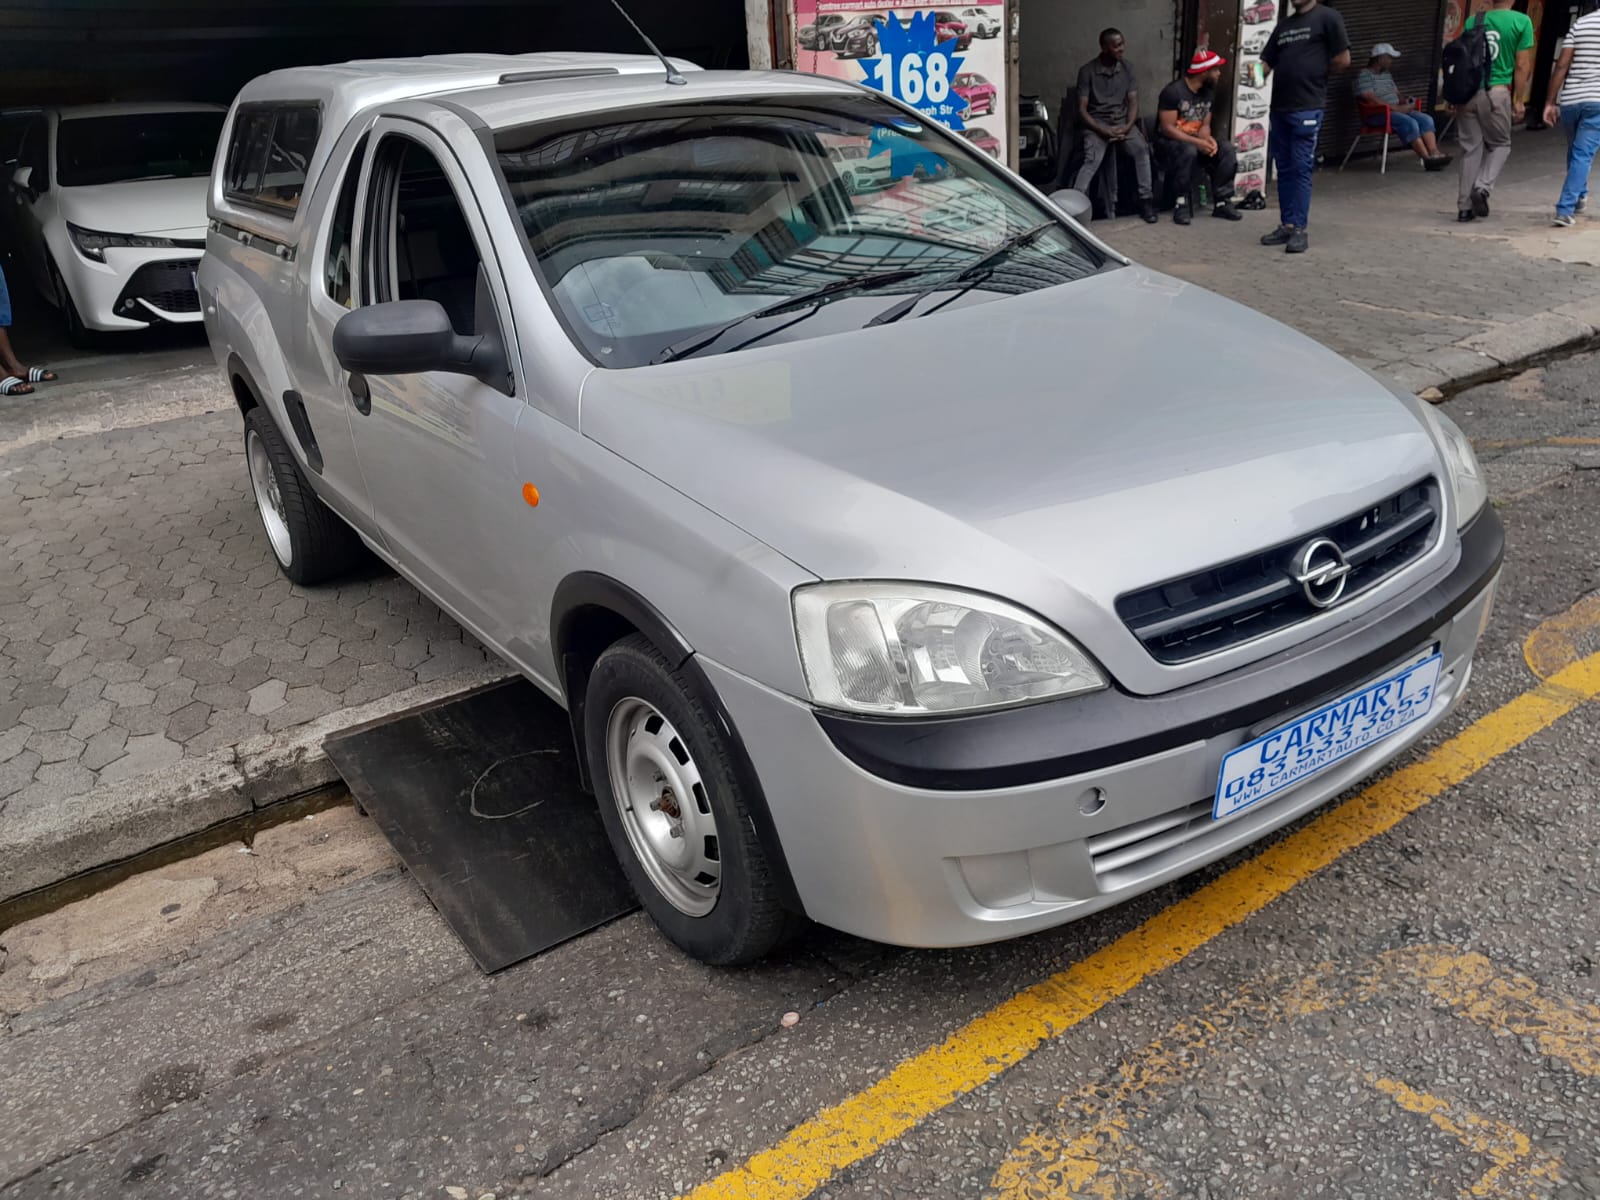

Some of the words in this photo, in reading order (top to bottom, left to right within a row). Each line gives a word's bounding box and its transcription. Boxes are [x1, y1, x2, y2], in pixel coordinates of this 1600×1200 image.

[874, 52, 950, 104] 168
[939, 104, 954, 116] Str
[1225, 756, 1287, 799] 083
[1296, 723, 1353, 764] 533
[1361, 685, 1431, 732] 3653
[1260, 673, 1412, 764] CARMART
